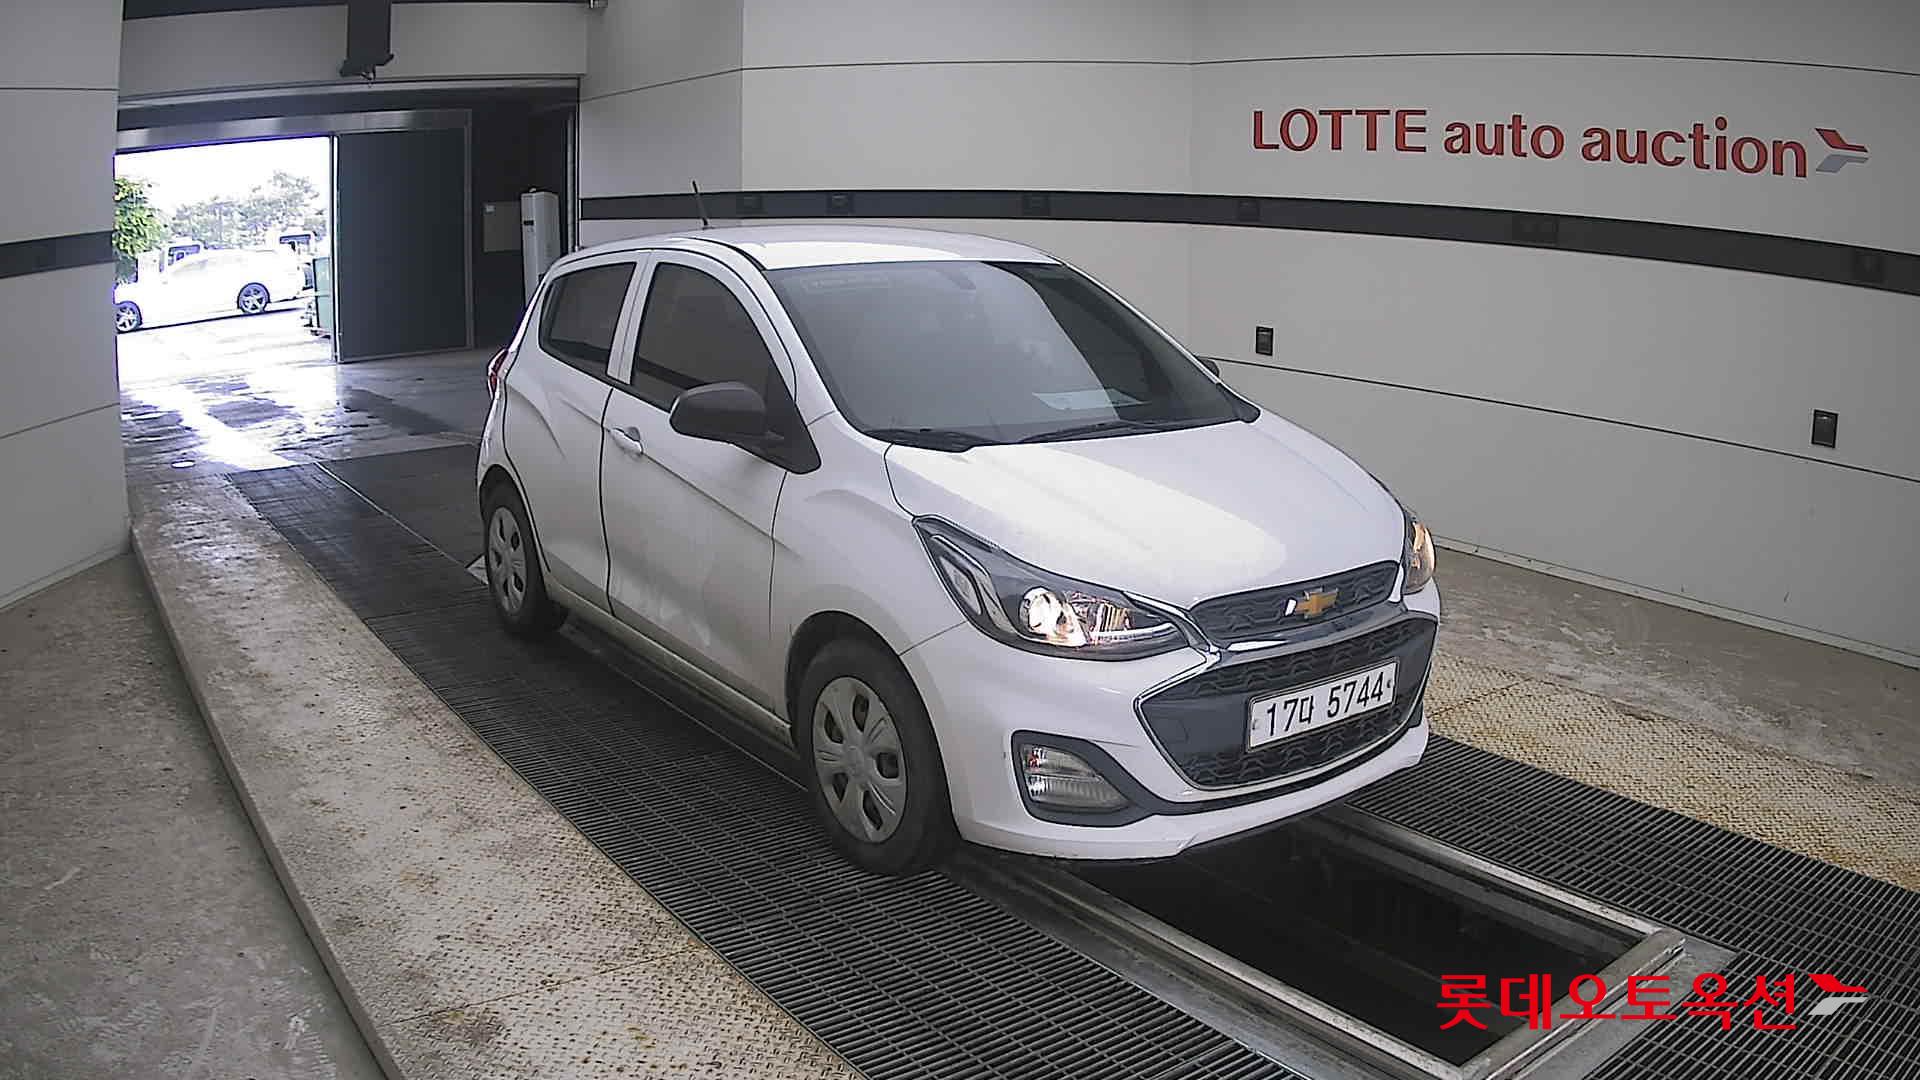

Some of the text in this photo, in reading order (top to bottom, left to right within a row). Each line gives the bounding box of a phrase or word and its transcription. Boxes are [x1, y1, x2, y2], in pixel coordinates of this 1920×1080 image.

[1253, 109, 1807, 178] LOTTE auto auction
[1327, 671, 1384, 718] 5744
